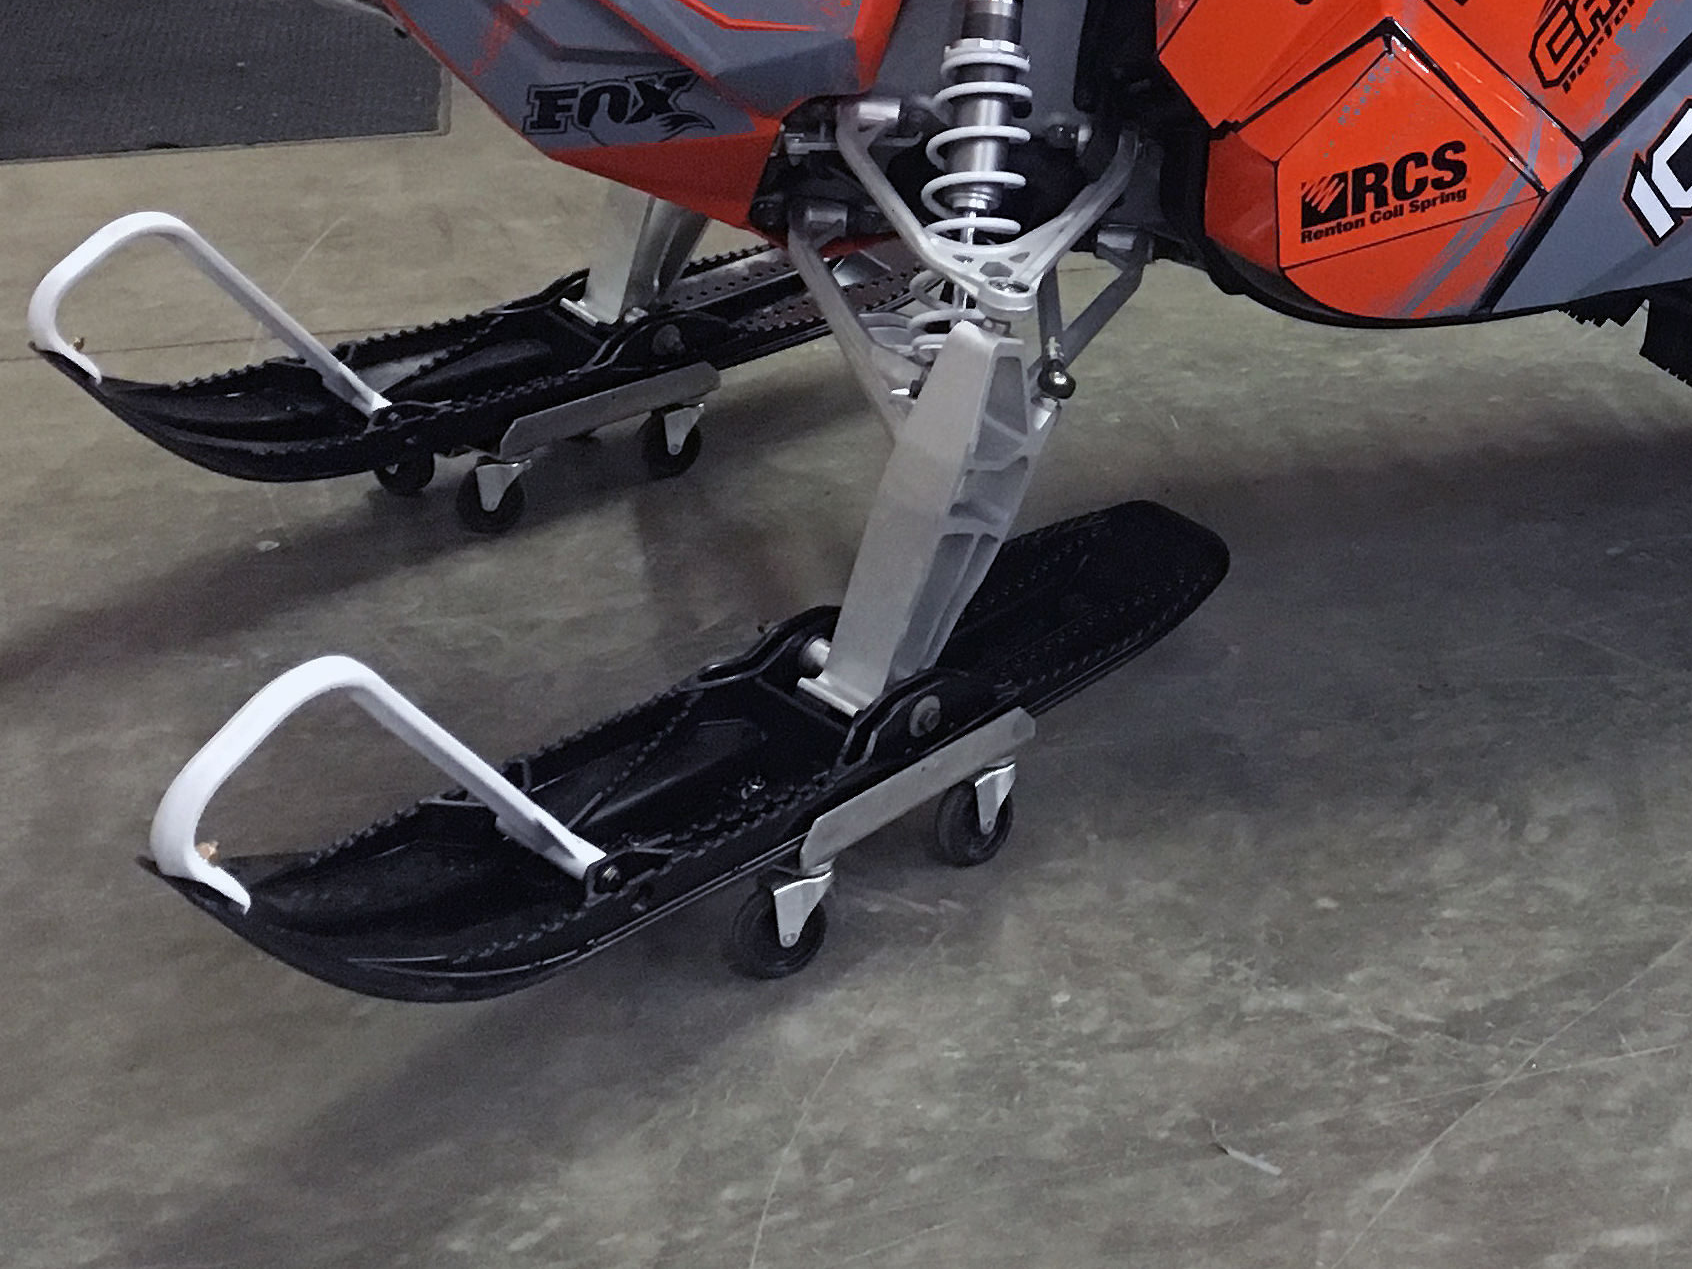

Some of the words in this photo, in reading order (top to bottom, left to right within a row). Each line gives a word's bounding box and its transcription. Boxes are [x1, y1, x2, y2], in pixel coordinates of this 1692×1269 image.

[522, 69, 701, 136] FOX
[1351, 140, 1468, 216] RCS
[1301, 216, 1366, 244] Renton
[1369, 204, 1404, 225] Coil
[1408, 188, 1467, 213] Spring
